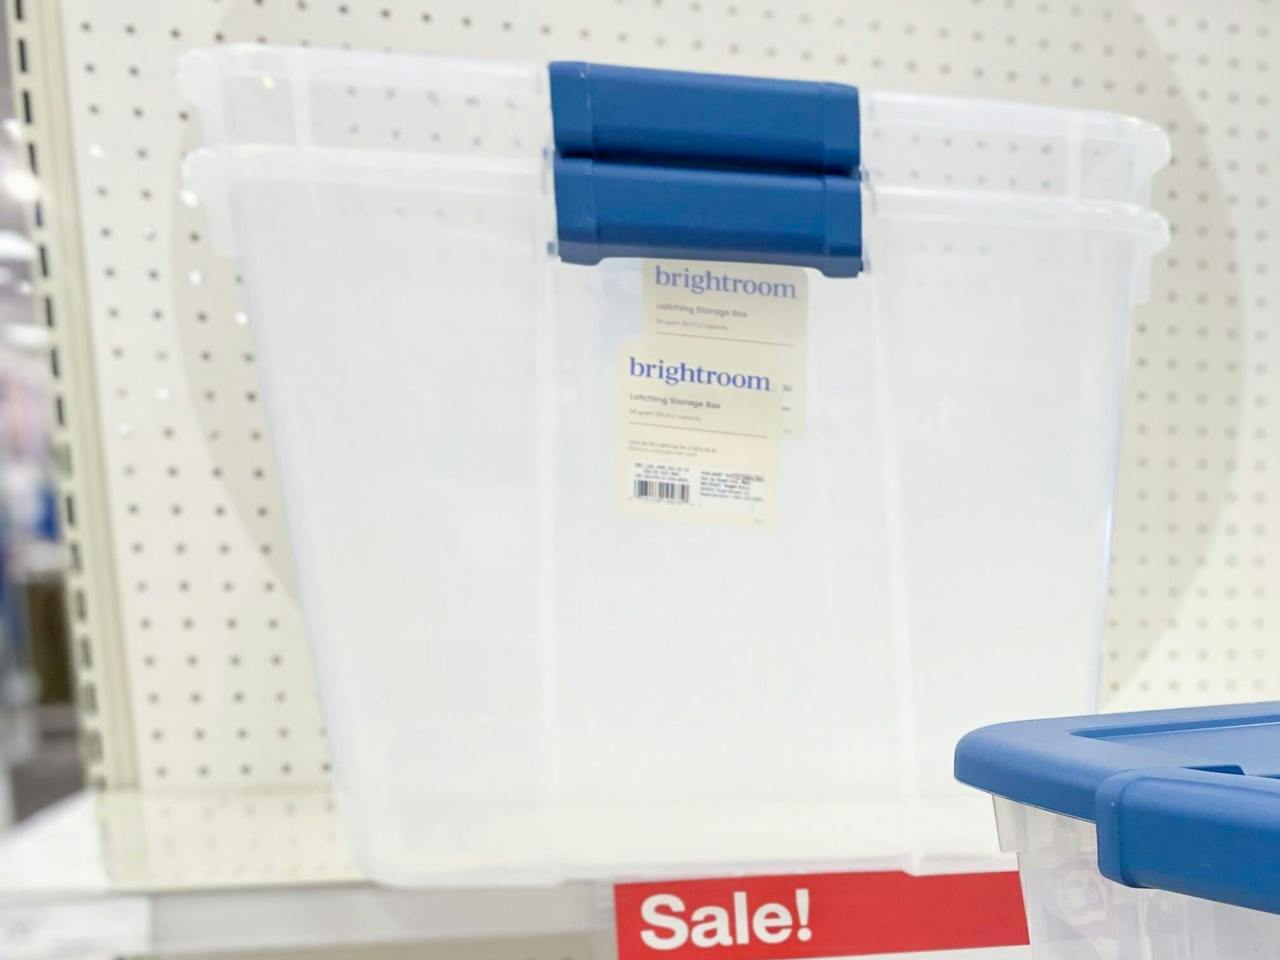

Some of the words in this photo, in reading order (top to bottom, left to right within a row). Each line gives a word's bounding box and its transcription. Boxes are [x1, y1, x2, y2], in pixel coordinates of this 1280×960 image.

[655, 265, 797, 299] brightroom
[629, 357, 771, 391] brightroom
[629, 393, 668, 405] Latching
[669, 397, 704, 408] Storage
[640, 888, 812, 950] Sale!
